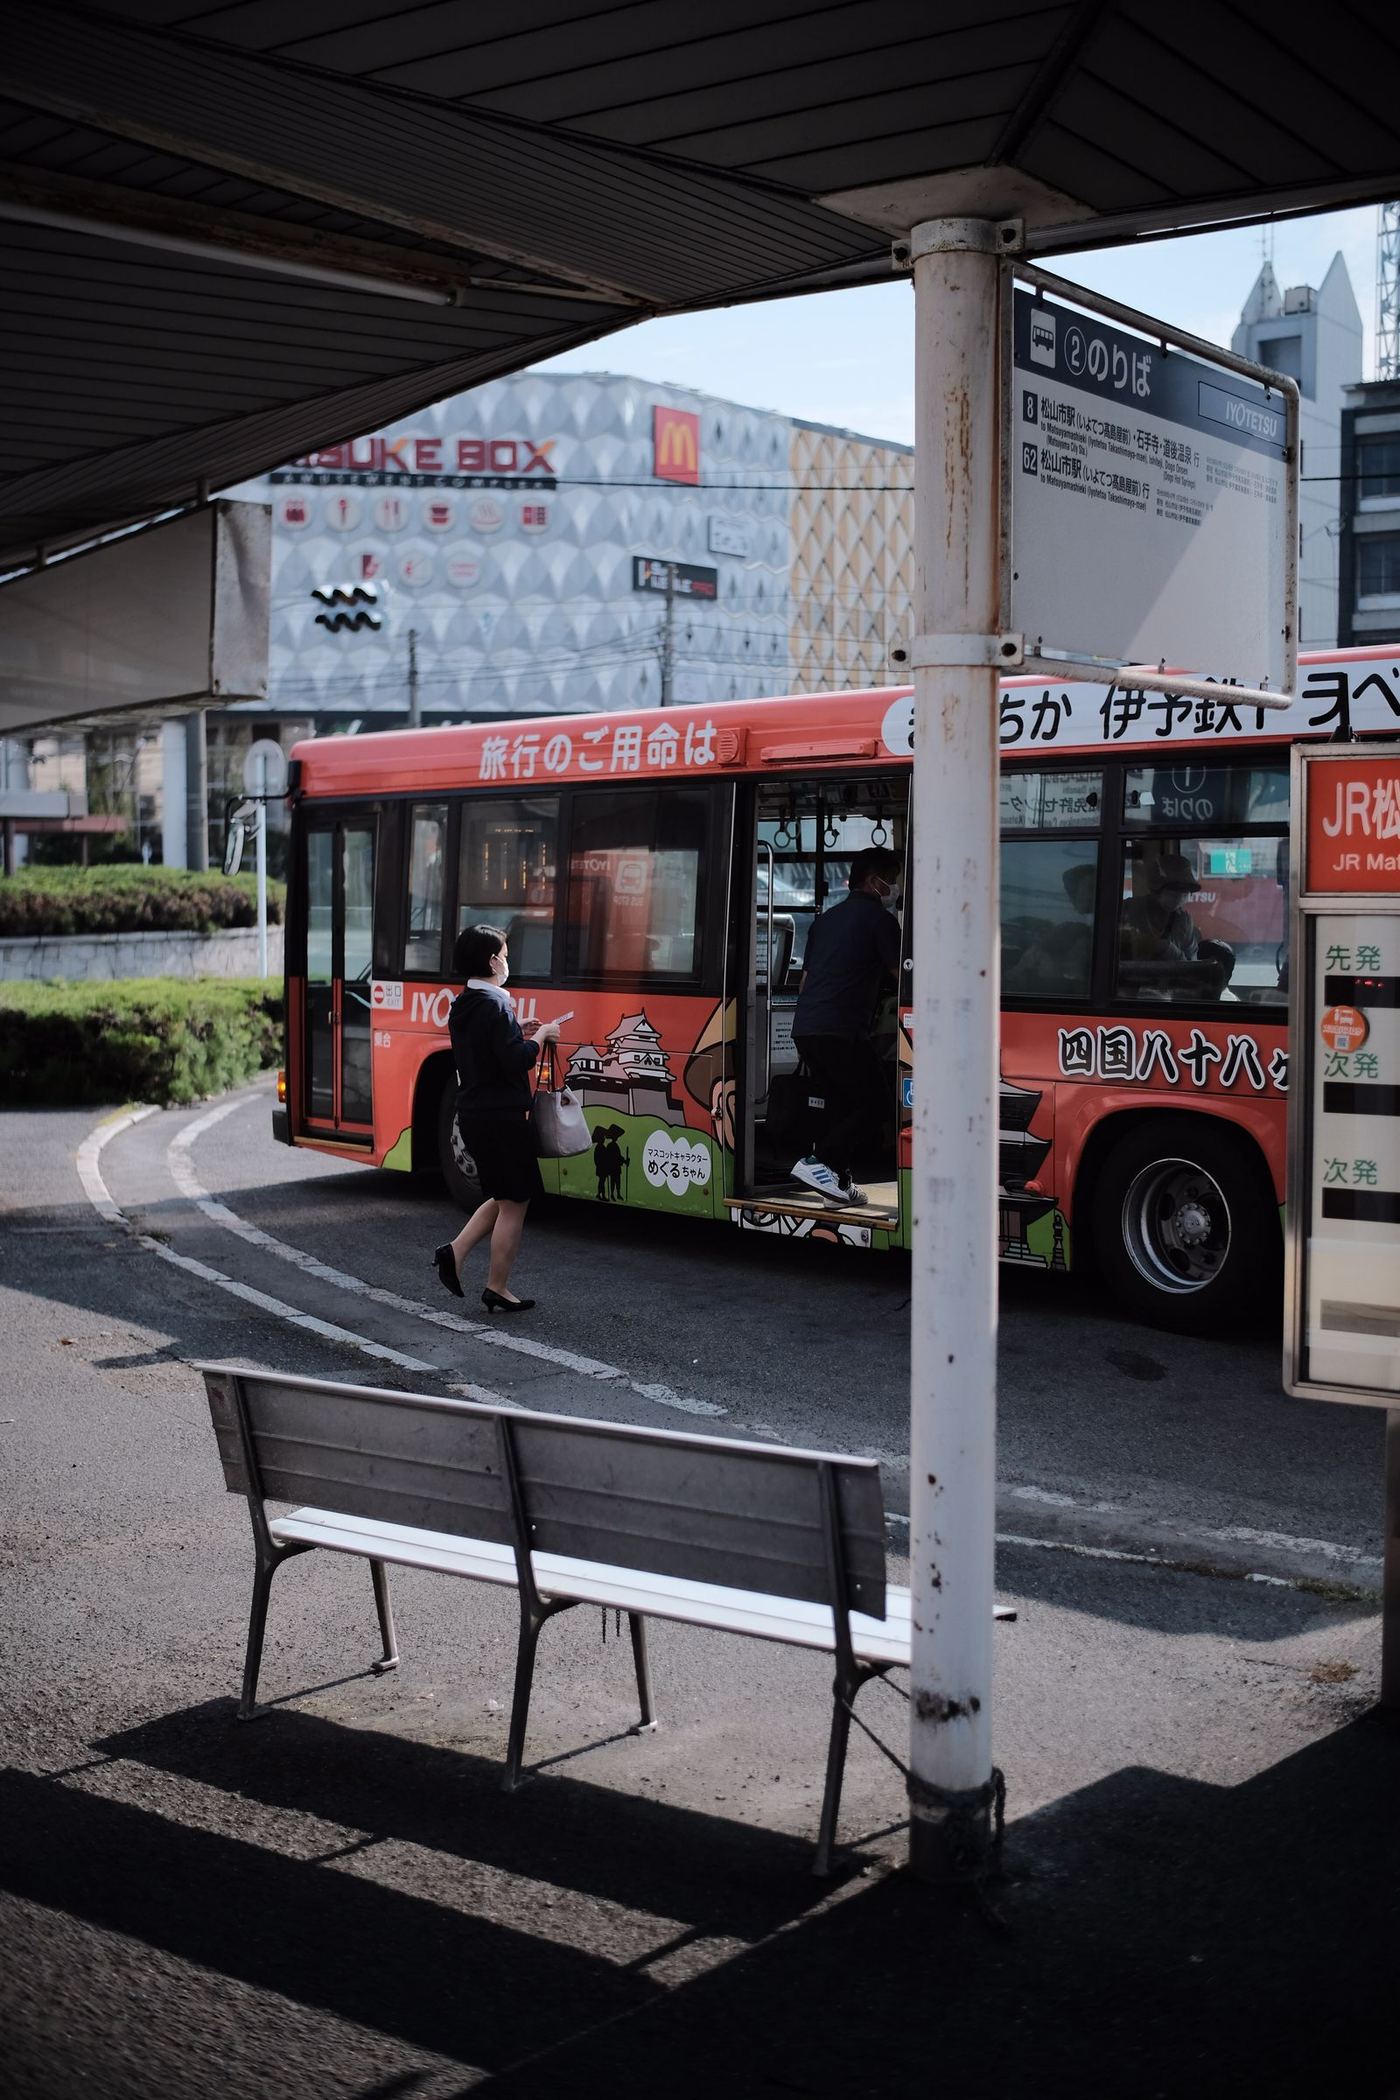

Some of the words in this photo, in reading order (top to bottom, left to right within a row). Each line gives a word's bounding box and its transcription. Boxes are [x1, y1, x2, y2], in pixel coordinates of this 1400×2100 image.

[1027, 396, 1034, 418] 8
[1226, 400, 1277, 437] IYOTETSU
[458, 439, 557, 474] BOX
[1023, 446, 1036, 471] 62
[478, 719, 718, 781] 旅行のご用命は
[1332, 853, 1360, 871] JR
[1325, 944, 1381, 972] 先発
[386, 984, 401, 997] 出口
[1324, 1052, 1379, 1079] 次発
[648, 1148, 708, 1163] マスコットキャラクター
[648, 1160, 705, 1179] めぐるちゃん
[1323, 1157, 1377, 1185] 次発
